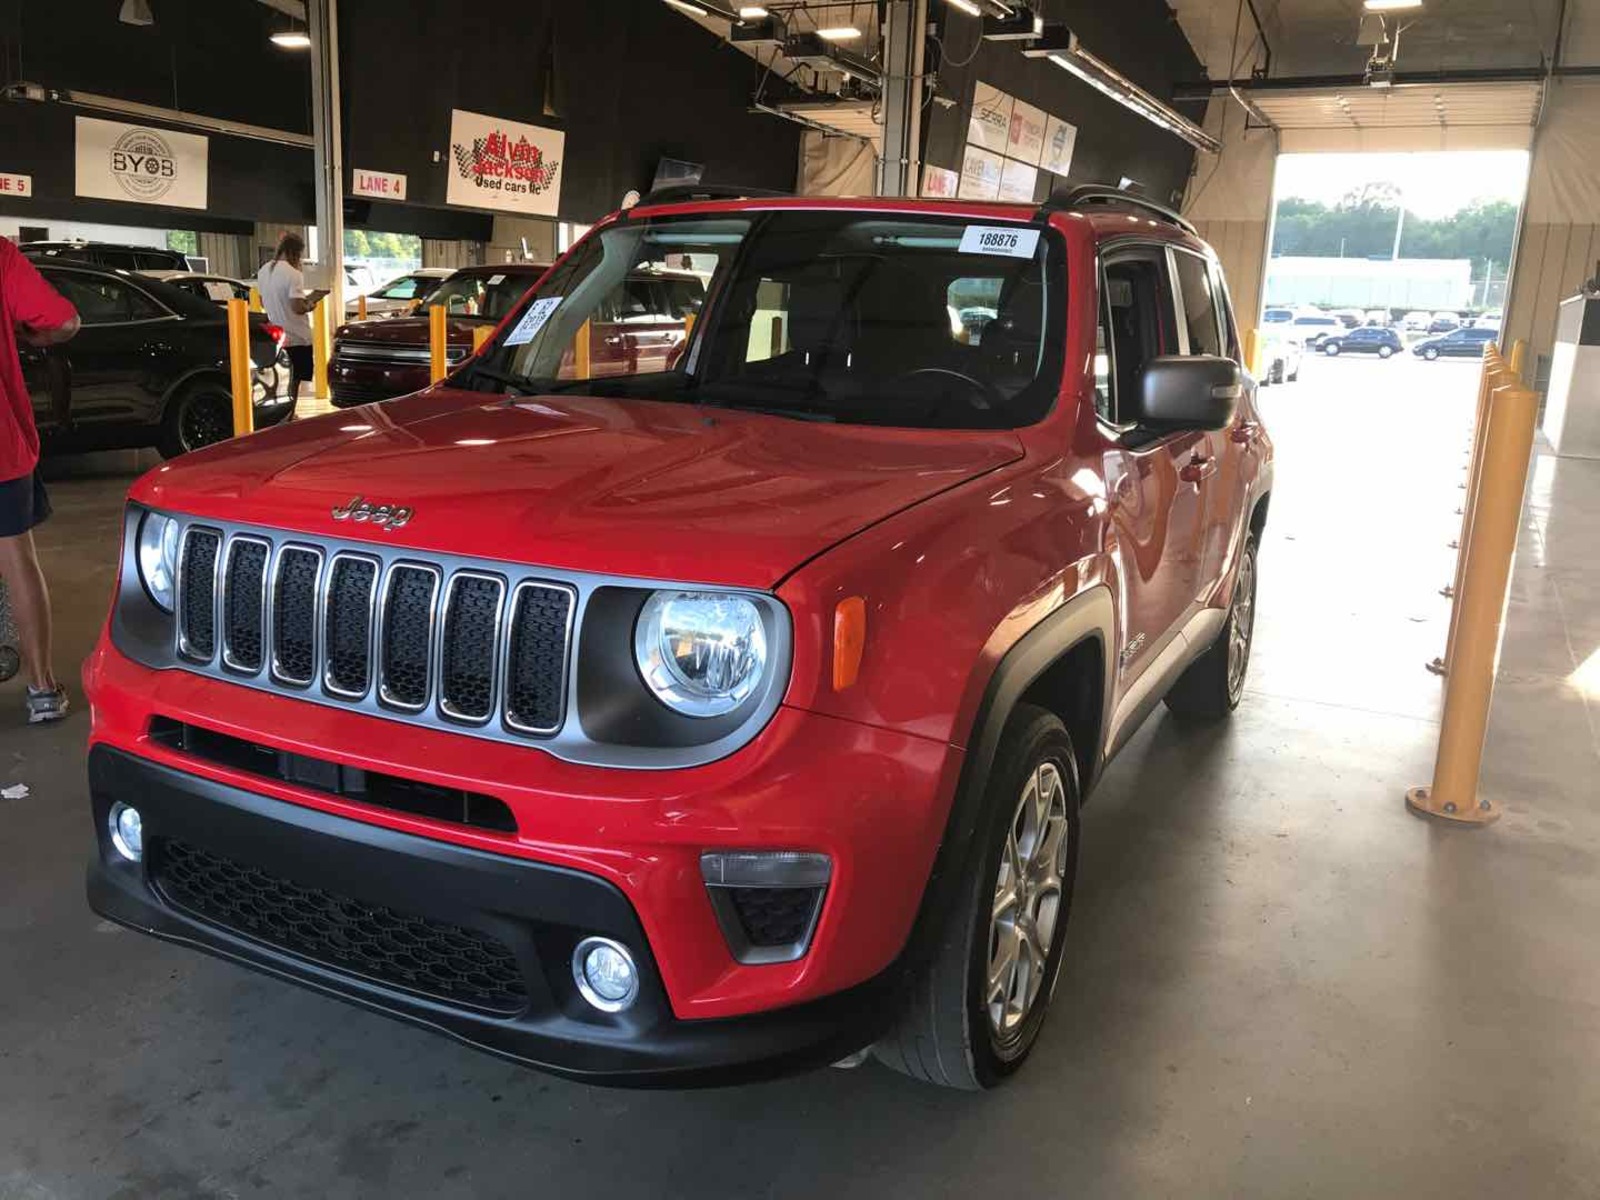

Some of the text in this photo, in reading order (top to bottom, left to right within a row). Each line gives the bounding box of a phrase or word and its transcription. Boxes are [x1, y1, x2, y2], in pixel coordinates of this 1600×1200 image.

[113, 152, 174, 177] BYOB
[471, 156, 544, 183] Jackson
[17, 179, 25, 192] 5
[359, 175, 400, 194] LANE 4
[475, 173, 502, 189] Used
[504, 182, 527, 194] cars
[979, 232, 1018, 248] 188876
[331, 495, 413, 532] Jeep
